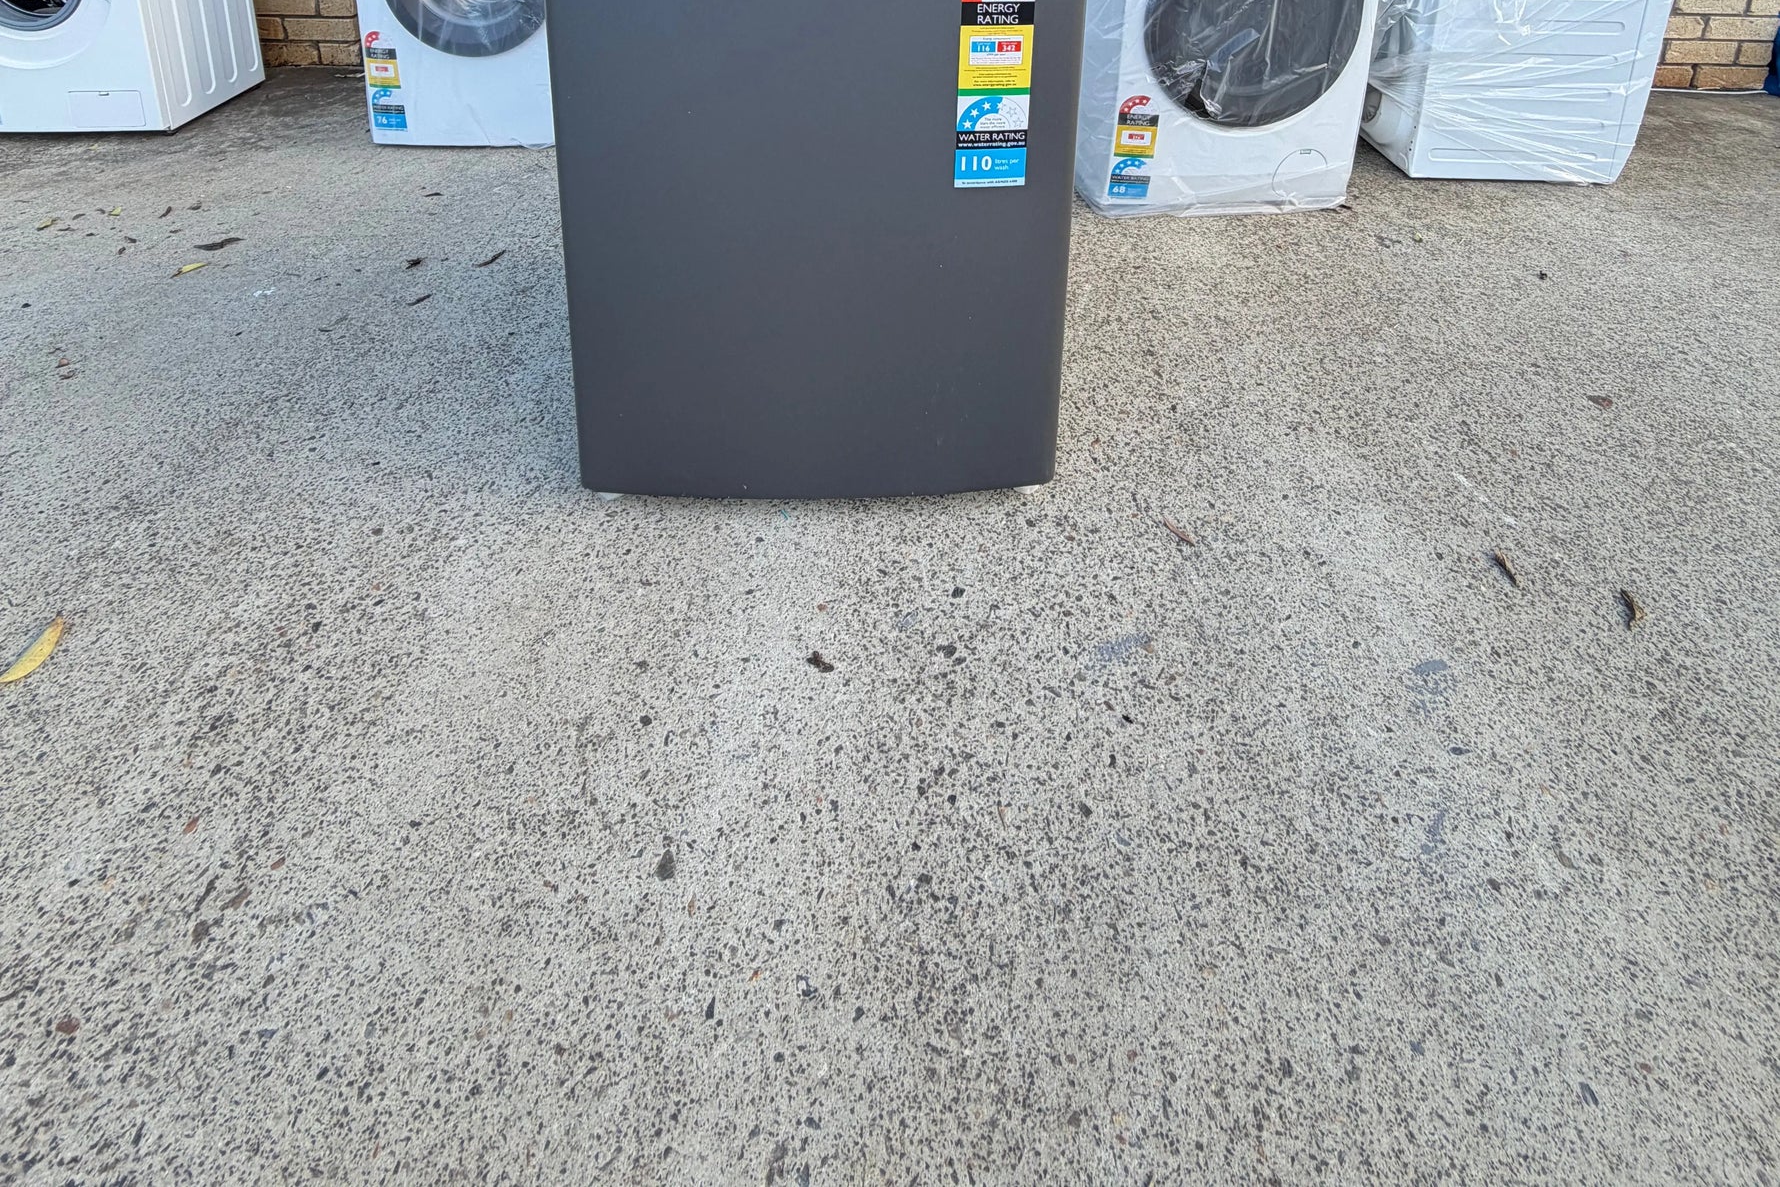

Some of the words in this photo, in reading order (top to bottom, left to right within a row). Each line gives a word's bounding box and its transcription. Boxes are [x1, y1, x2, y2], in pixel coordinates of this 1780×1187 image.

[977, 4, 1020, 13] ENERGY
[977, 15, 1019, 24] RATING
[376, 116, 388, 124] 76
[958, 133, 990, 141] WATER
[992, 132, 1025, 140] RATING
[961, 155, 992, 171] 110
